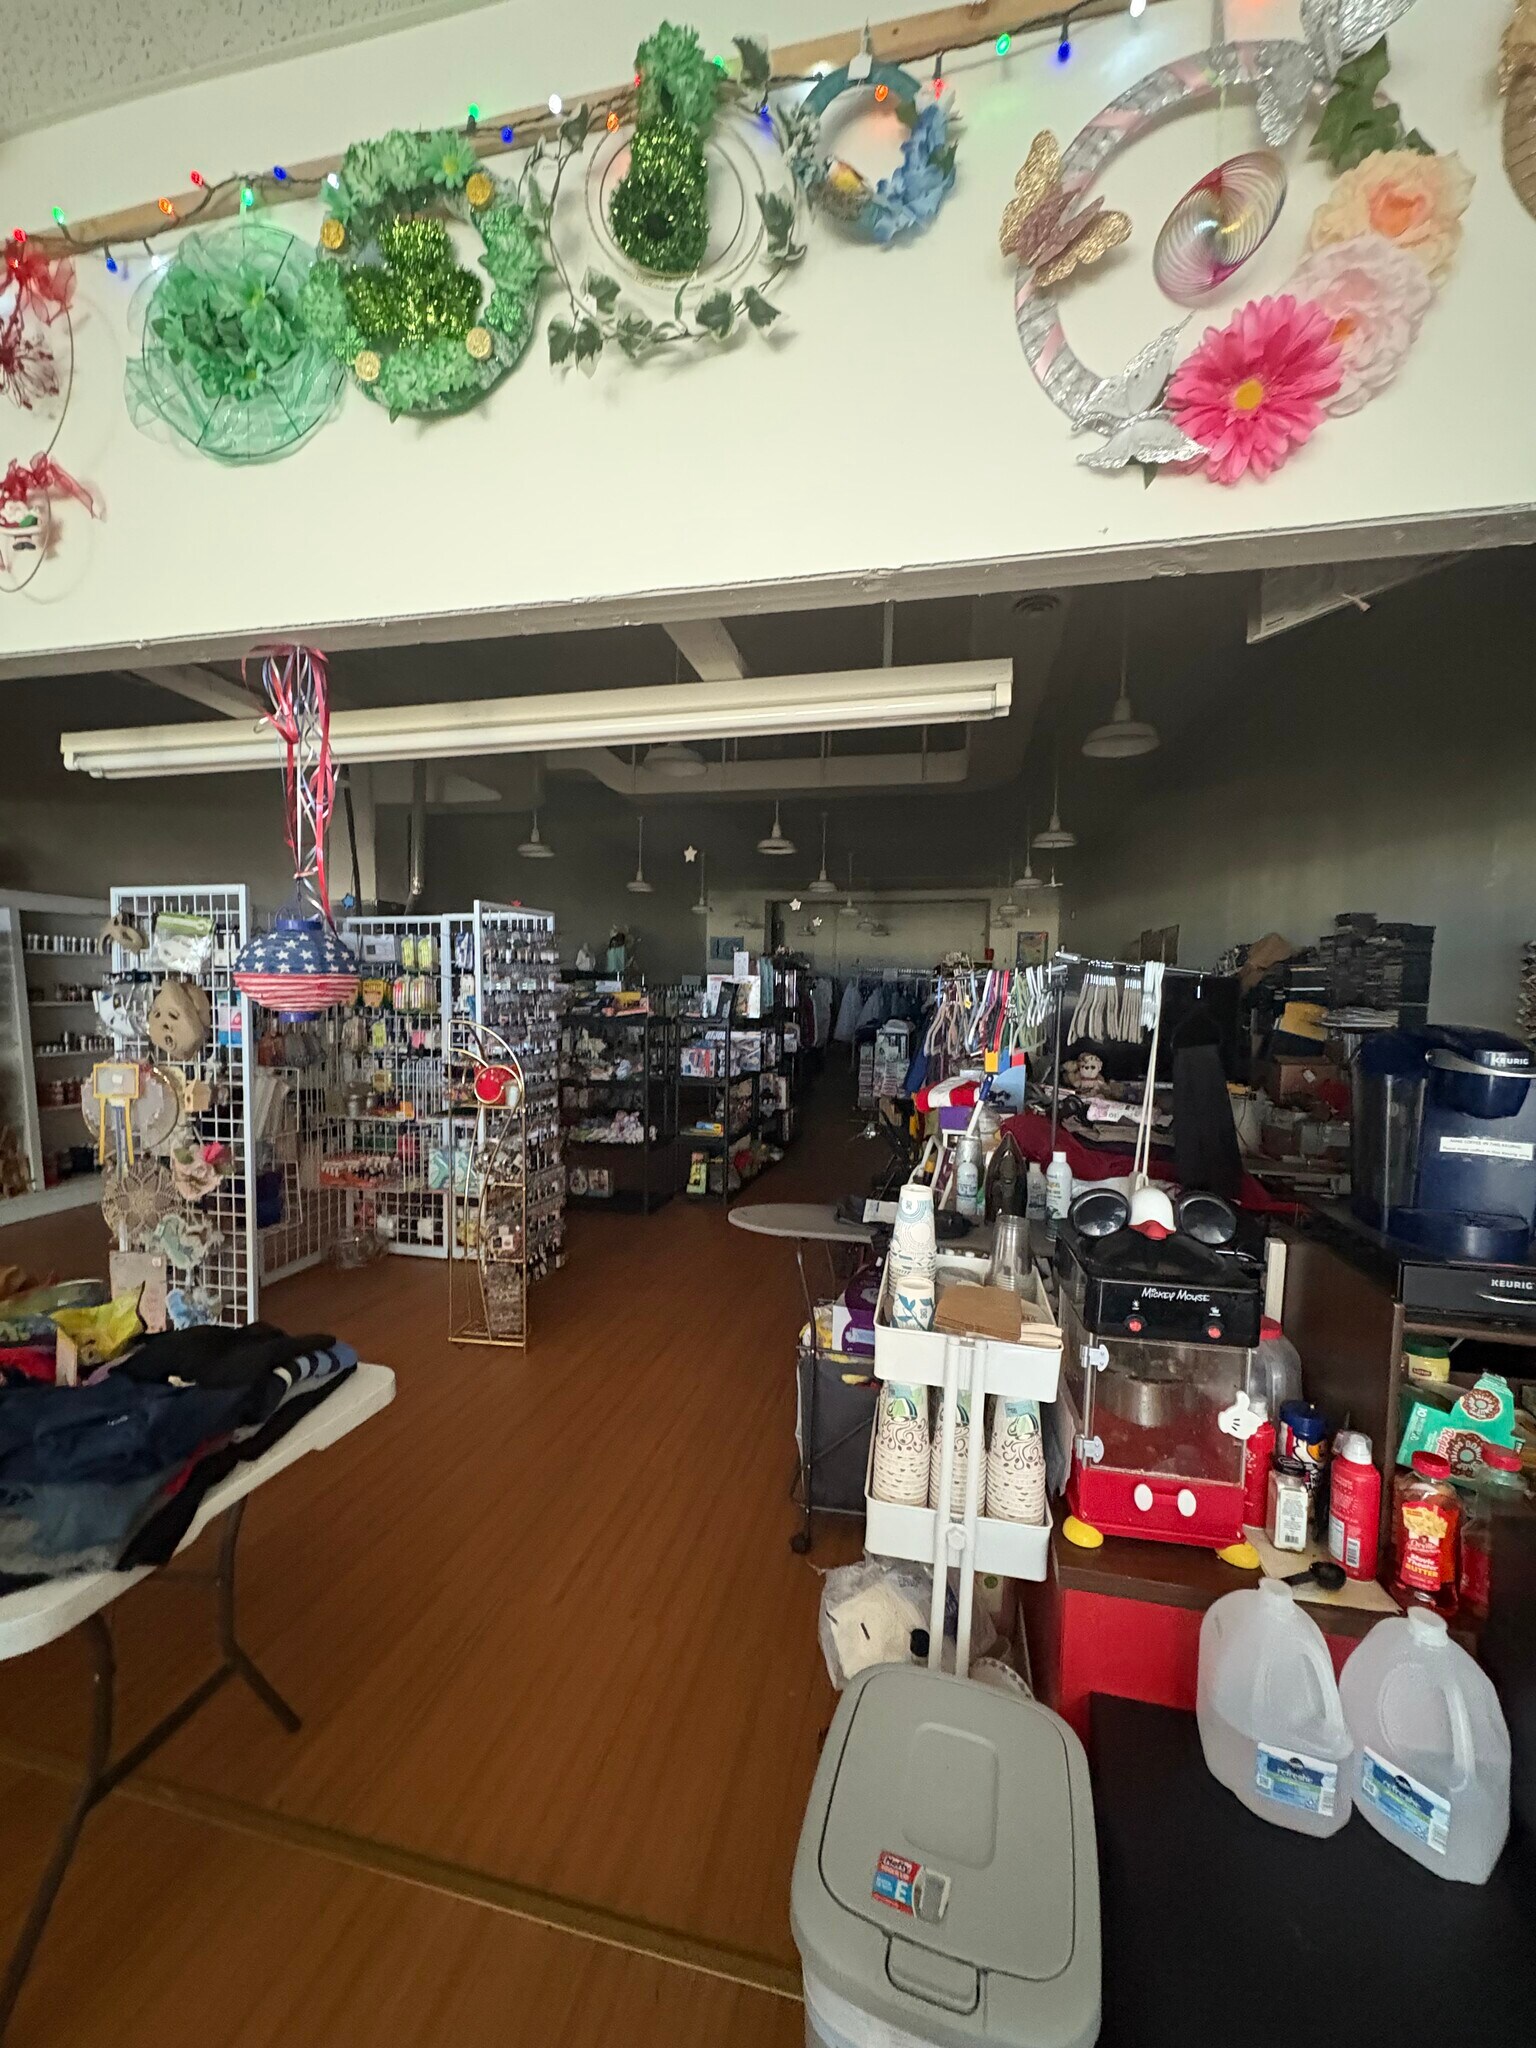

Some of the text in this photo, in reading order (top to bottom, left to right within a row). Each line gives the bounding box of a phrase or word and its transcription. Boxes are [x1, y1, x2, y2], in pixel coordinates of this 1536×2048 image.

[1490, 1056, 1530, 1066] KEURIG
[1490, 1278, 1534, 1290] KEURIG
[1409, 1552, 1436, 1566] Movie
[1405, 1563, 1439, 1578] BUTTER
